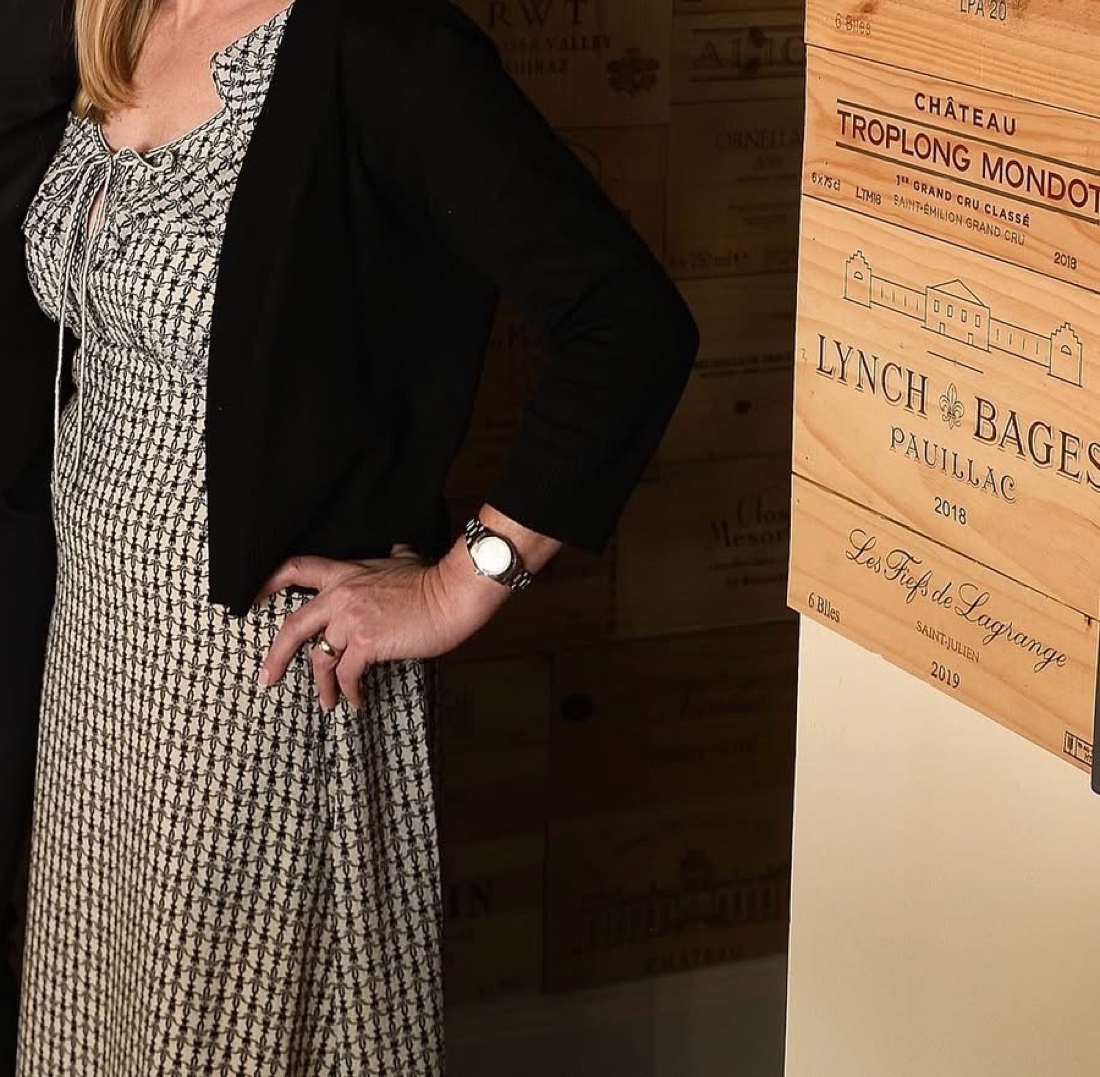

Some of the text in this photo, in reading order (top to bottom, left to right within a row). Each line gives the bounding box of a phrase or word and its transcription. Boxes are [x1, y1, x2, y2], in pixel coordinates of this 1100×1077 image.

[914, 91, 1017, 137] CHÂTEAU
[837, 108, 971, 174] TROPLONG
[981, 150, 1100, 215] MONDOT
[912, 180, 953, 203] GRAND
[956, 193, 981, 212] CRU
[984, 202, 1031, 228] CLASSÉ
[965, 216, 1002, 239] GRAND
[1004, 229, 1026, 247] CRU
[1053, 251, 1079, 271] 2018
[815, 332, 1100, 492] LYNCH BAGES
[889, 424, 1019, 504] PAUILLAC
[933, 495, 968, 527] 2018
[845, 528, 1069, 674] Les Fiefs de Lagrange
[930, 659, 962, 690] 2019
